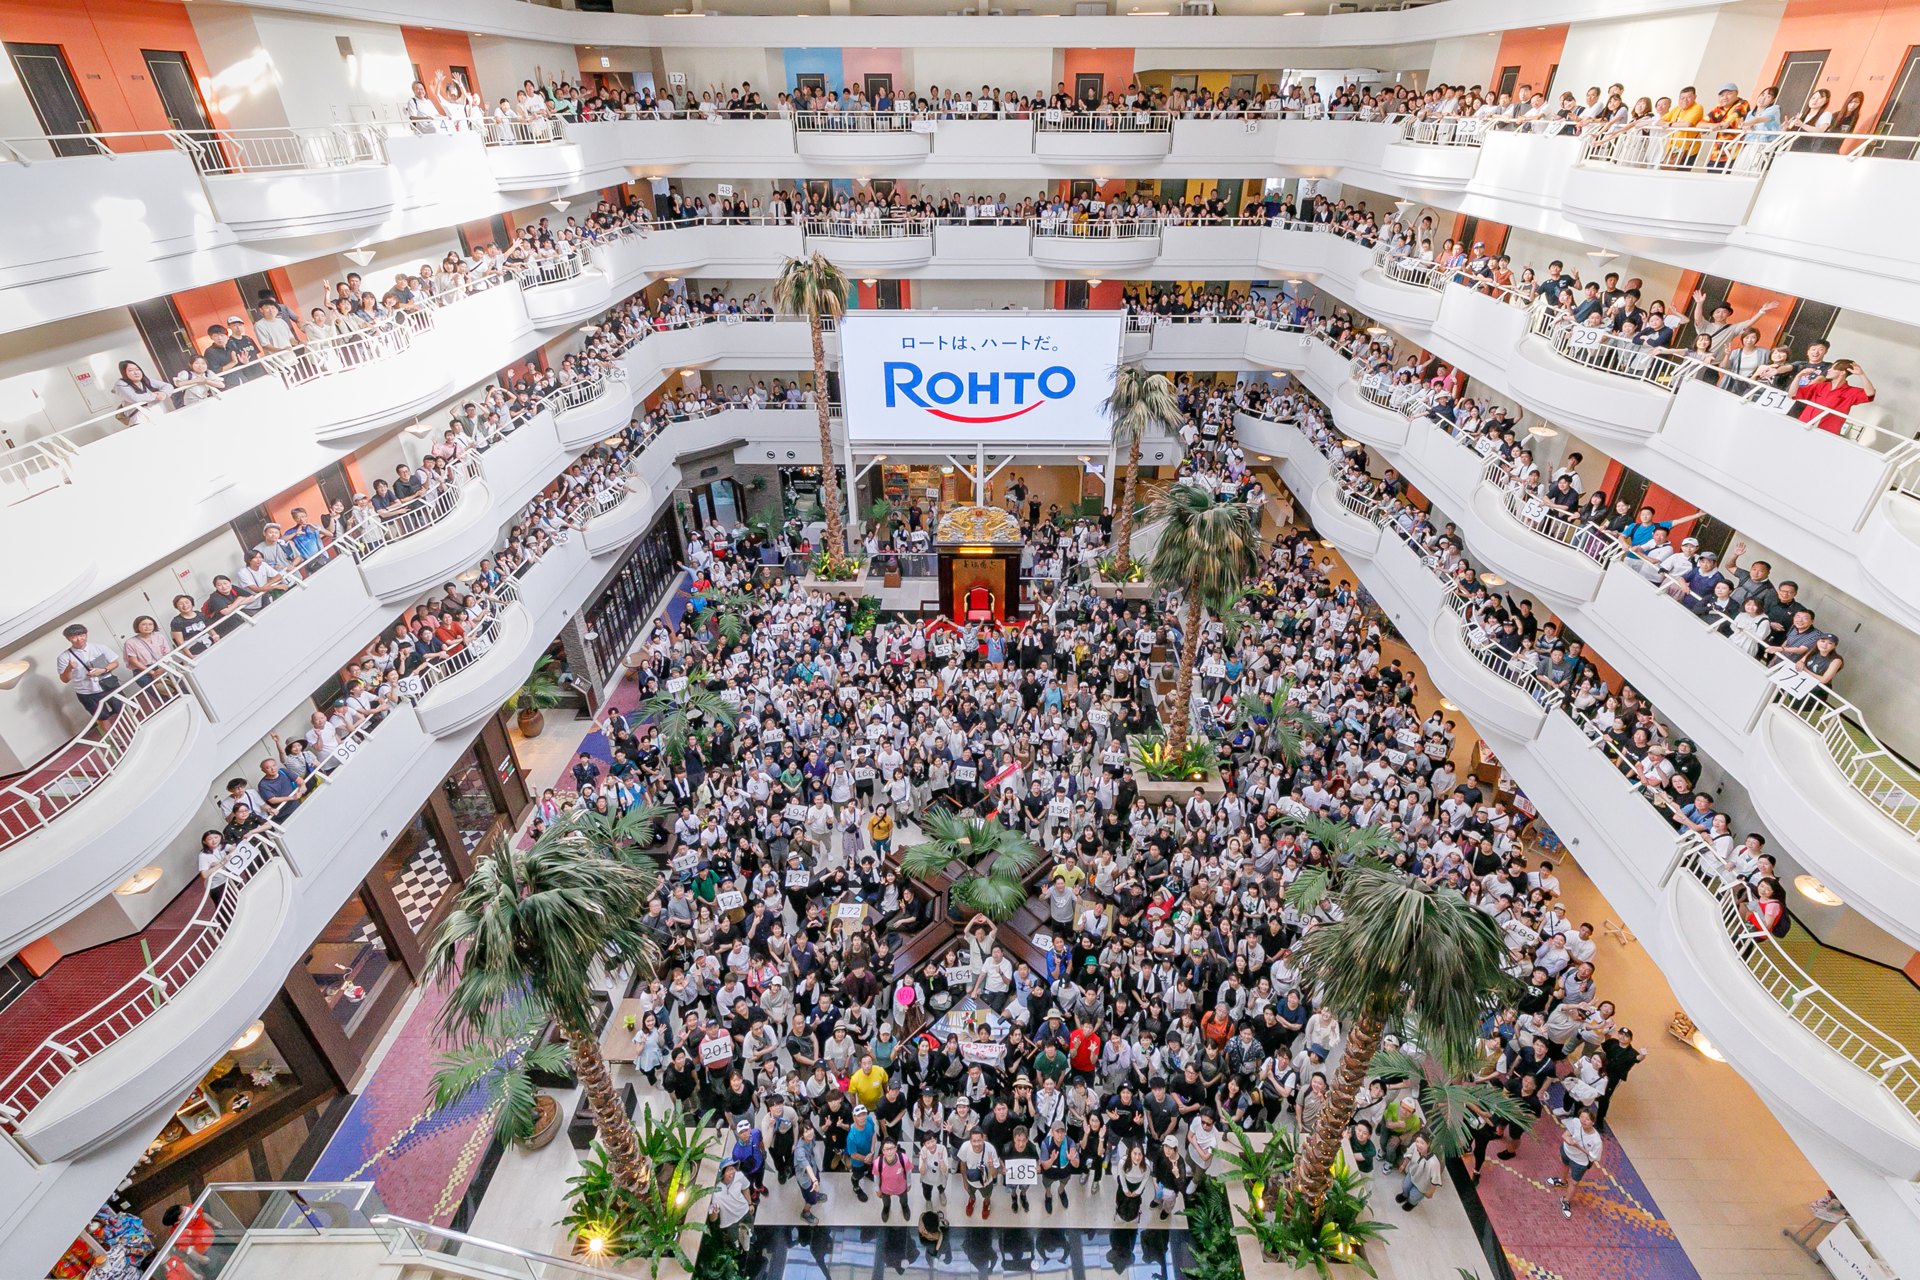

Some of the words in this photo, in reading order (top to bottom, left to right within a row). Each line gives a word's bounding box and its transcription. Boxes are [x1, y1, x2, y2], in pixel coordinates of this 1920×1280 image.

[673, 74, 683, 83] 12
[898, 102, 909, 111] 15
[959, 103, 969, 112] 24
[982, 102, 988, 111] 2
[1268, 101, 1279, 109] 17
[1307, 105, 1318, 114] 11
[1048, 112, 1059, 120] 19
[1138, 113, 1148, 122] 20
[1245, 122, 1256, 133] 16
[1460, 120, 1476, 133] 23
[719, 185, 731, 194] 48
[1305, 186, 1316, 196] 26
[983, 205, 994, 214] 44
[1273, 217, 1283, 226] 50
[728, 315, 738, 323] 62
[1140, 316, 1150, 324] 67
[1159, 318, 1170, 327] 72
[1258, 320, 1269, 329] 54
[1301, 336, 1311, 345] 76
[1574, 330, 1597, 345] 29
[902, 335, 1058, 352] ロートは、ハートだ。
[614, 370, 626, 379] 64
[883, 361, 1076, 408] ROHTO
[1365, 376, 1378, 387] 58
[1761, 390, 1786, 410] 51
[1478, 437, 1491, 454] 59
[598, 492, 610, 501] 99
[1525, 502, 1542, 518] 53
[937, 645, 949, 654] 55
[733, 653, 748, 664] 144
[1210, 666, 1224, 676] 123
[1778, 667, 1809, 694] 71
[398, 678, 418, 694] 86
[722, 692, 738, 701] 212
[841, 689, 857, 697] 118
[1090, 711, 1106, 722] 198
[765, 732, 783, 743] 116
[1397, 729, 1417, 742] 214
[337, 741, 357, 760] 96
[1430, 745, 1446, 755] 129
[1104, 754, 1123, 764] 216
[1387, 750, 1404, 762] 179
[857, 771, 875, 781] 166
[957, 770, 975, 780] 146
[787, 807, 806, 818] 194
[1051, 806, 1069, 816] 156
[229, 845, 253, 871] 93
[677, 856, 696, 870] 112
[788, 873, 808, 884] 126
[721, 895, 742, 909] 175
[839, 906, 861, 916] 172
[1511, 923, 1535, 942] 189
[1035, 937, 1053, 949] 13
[950, 969, 971, 981] 164
[704, 1042, 731, 1057] 201
[1008, 1164, 1036, 1180] 185
